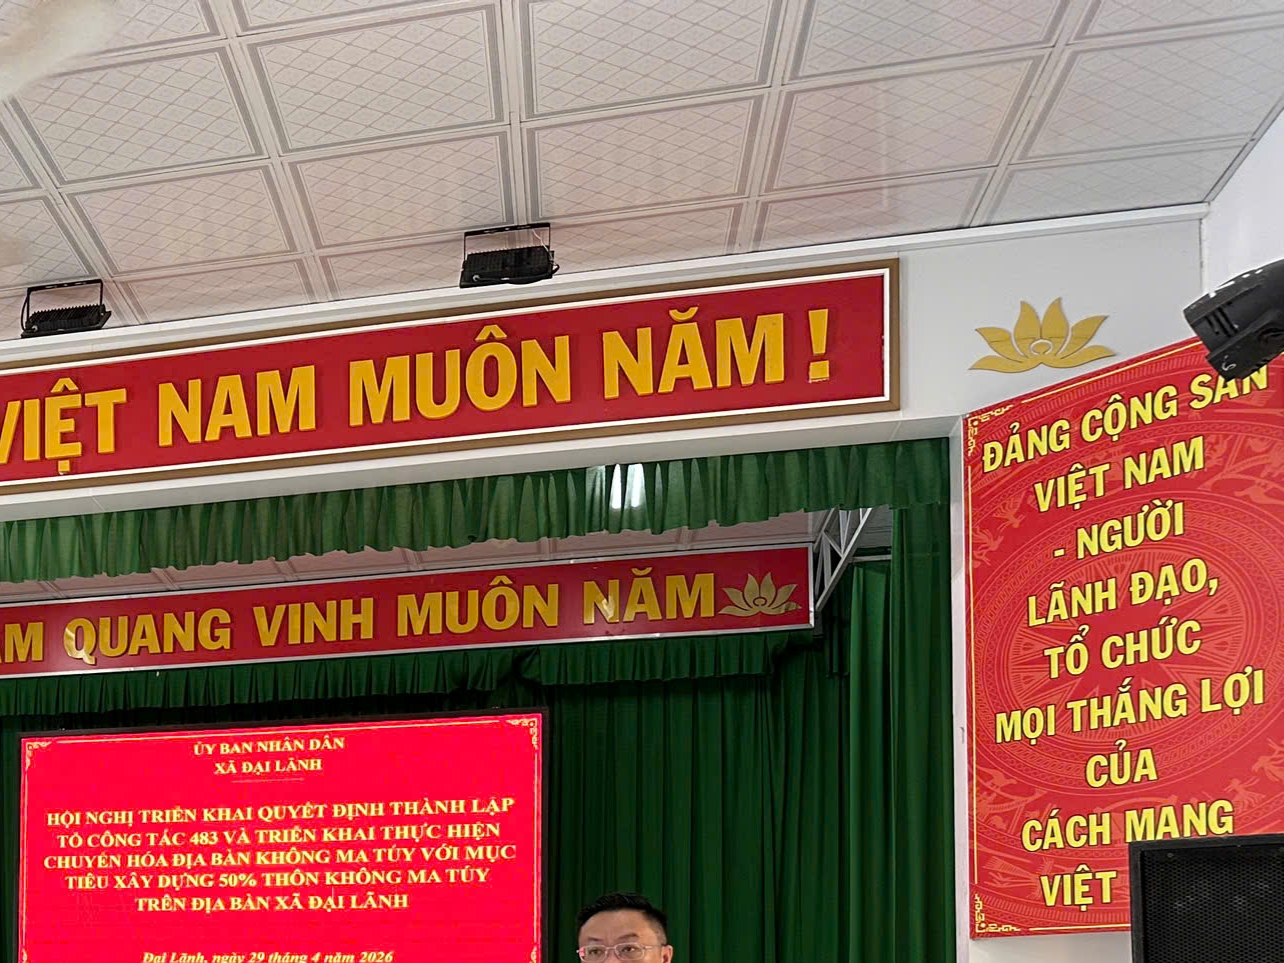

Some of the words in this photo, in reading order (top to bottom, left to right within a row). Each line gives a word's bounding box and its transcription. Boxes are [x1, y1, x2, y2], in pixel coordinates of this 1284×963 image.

[159, 366, 315, 446] NAM
[350, 325, 570, 425] MUÔN
[603, 307, 784, 398] NĂM
[809, 309, 829, 382] !
[983, 420, 1069, 472] ĐẢNG
[1082, 386, 1177, 441] CỘNG
[1035, 449, 1109, 511] VIỆT
[1125, 436, 1203, 488] NAM
[1075, 495, 1183, 558] NGƯỜI
[64, 609, 230, 664] QUANG
[254, 598, 373, 646] VINH
[398, 576, 558, 636] MUÔN
[584, 568, 714, 623] NĂM
[1029, 578, 1116, 629] LÃNH
[1130, 559, 1217, 604] ĐẠO,
[1045, 625, 1089, 678] TỔ
[1102, 618, 1200, 668] CHỨC
[997, 706, 1054, 744] MỌI
[1067, 684, 1186, 731] THẮNG
[1202, 666, 1263, 714] LỢI
[214, 760, 237, 774] XÃ
[242, 761, 270, 775] ĐẠI
[275, 758, 322, 771] LÃNH
[220, 742, 253, 754] BAN
[257, 737, 304, 752] NHÂN
[309, 735, 344, 750] DÂN
[1087, 740, 1157, 787] CỦA
[48, 810, 81, 828] HỘI
[86, 811, 133, 827] NGHỊ
[203, 807, 252, 821] KHAI
[332, 803, 384, 820] ĐỊNH
[389, 798, 465, 815] THÀNH
[87, 830, 141, 847] CÔNG
[146, 829, 185, 846] TÁC
[190, 831, 218, 845] 483
[223, 828, 251, 844] VÀ
[322, 826, 375, 842] KHAI
[380, 823, 441, 842] THỰC
[448, 822, 500, 840] HIỆN
[1023, 810, 1110, 851] CÁCH
[65, 873, 108, 889] TIÊU
[114, 872, 153, 888] XÂY
[158, 872, 214, 891] DỰNG
[219, 873, 257, 887] 50%
[261, 869, 319, 886] THÔN
[325, 867, 401, 885] KHÔNG
[408, 870, 442, 883] MA
[445, 865, 489, 882] TÚY
[172, 853, 207, 869] ĐỊA
[256, 847, 330, 864] KHÔNG
[336, 849, 369, 863] MA
[373, 844, 415, 862] TÚY
[421, 843, 459, 861] VỚI
[465, 845, 516, 862] MỤC
[135, 894, 186, 911] TRÊN
[191, 898, 225, 913] ĐỊA
[275, 893, 303, 910] XÃ
[308, 894, 344, 912] ĐẠI
[350, 891, 408, 908] LÃNH
[1041, 865, 1116, 911] VIỆT
[170, 952, 208, 963] Lãnh,
[248, 952, 265, 963] 29
[311, 952, 320, 963] 4
[324, 952, 355, 963] năm
[360, 951, 393, 963] 2026
